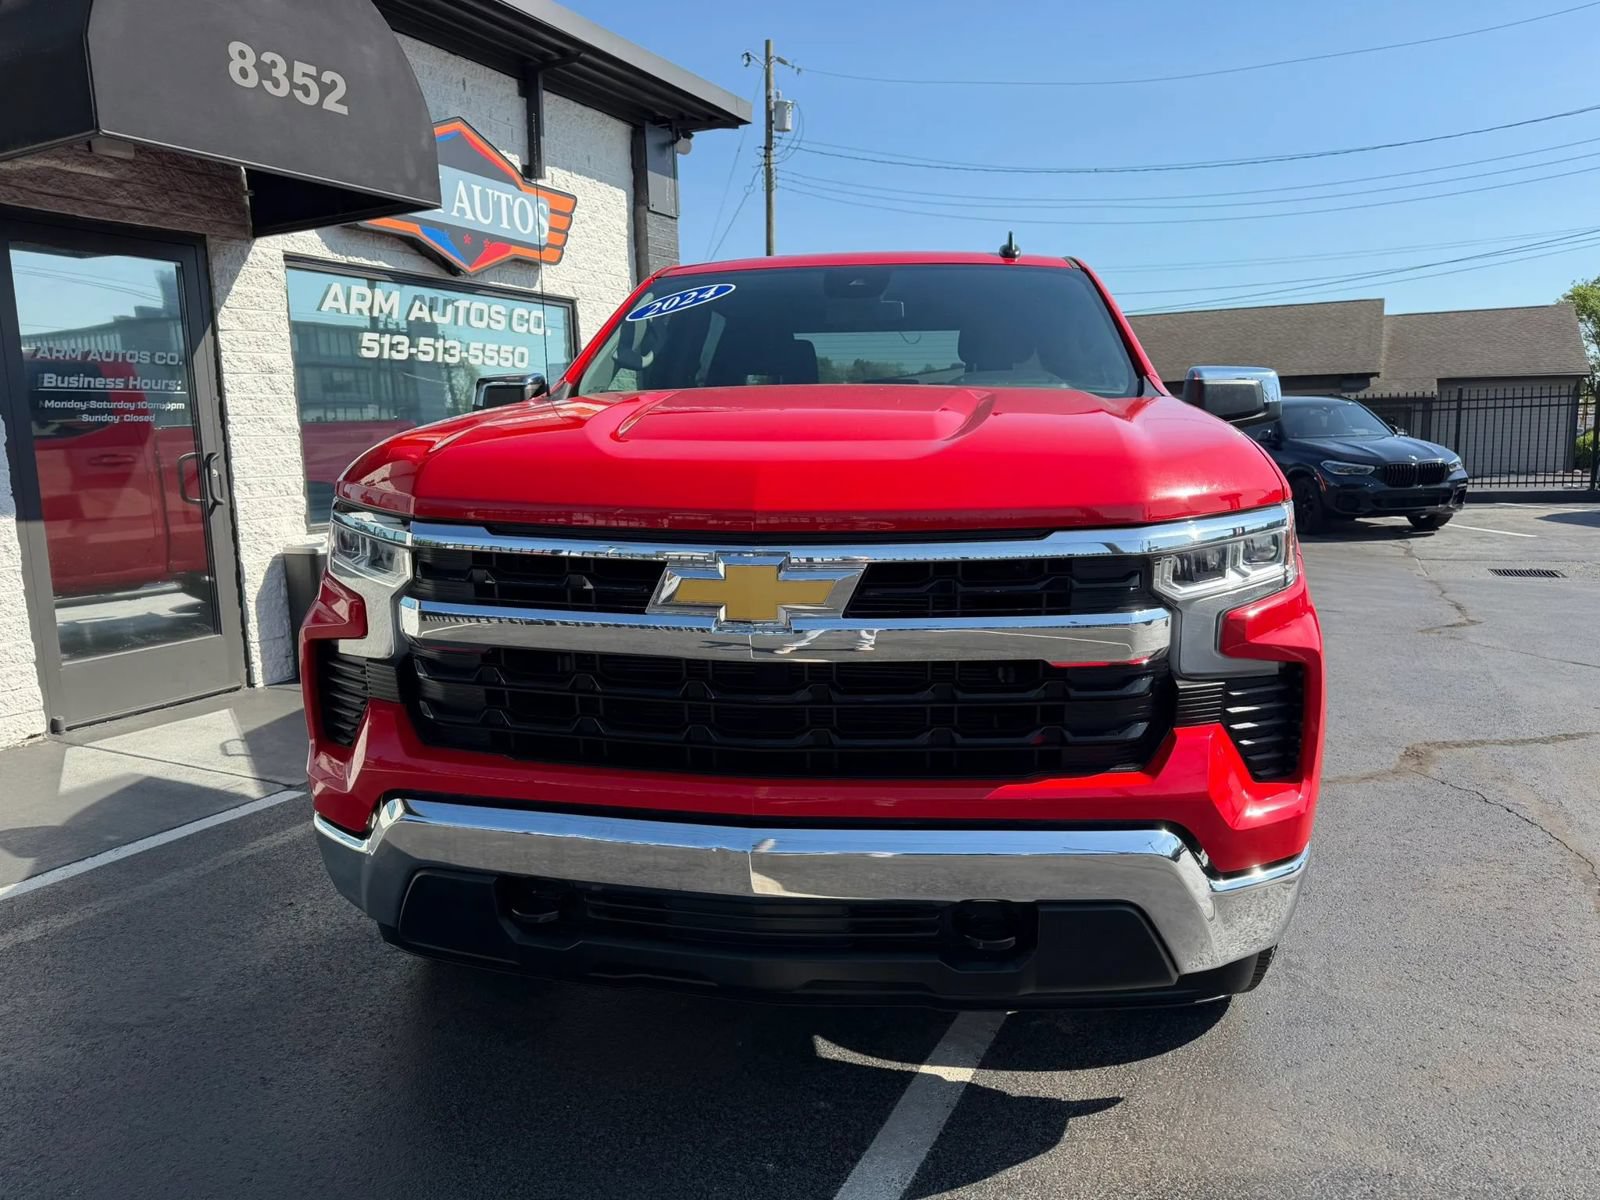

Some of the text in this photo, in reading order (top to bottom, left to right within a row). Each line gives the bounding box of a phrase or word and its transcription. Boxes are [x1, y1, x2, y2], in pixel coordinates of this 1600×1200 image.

[228, 41, 349, 115] 8352
[450, 180, 549, 238] AUTOS
[320, 283, 552, 337] ARM AUTOS CO.
[642, 285, 719, 318] 2024
[36, 346, 183, 366] ARM AUTOS CO.
[360, 331, 529, 369] 513-513-5550
[43, 373, 182, 391] Business Hours:
[44, 399, 136, 411] Monday-Saturday
[81, 413, 155, 424] Sunday Closed
